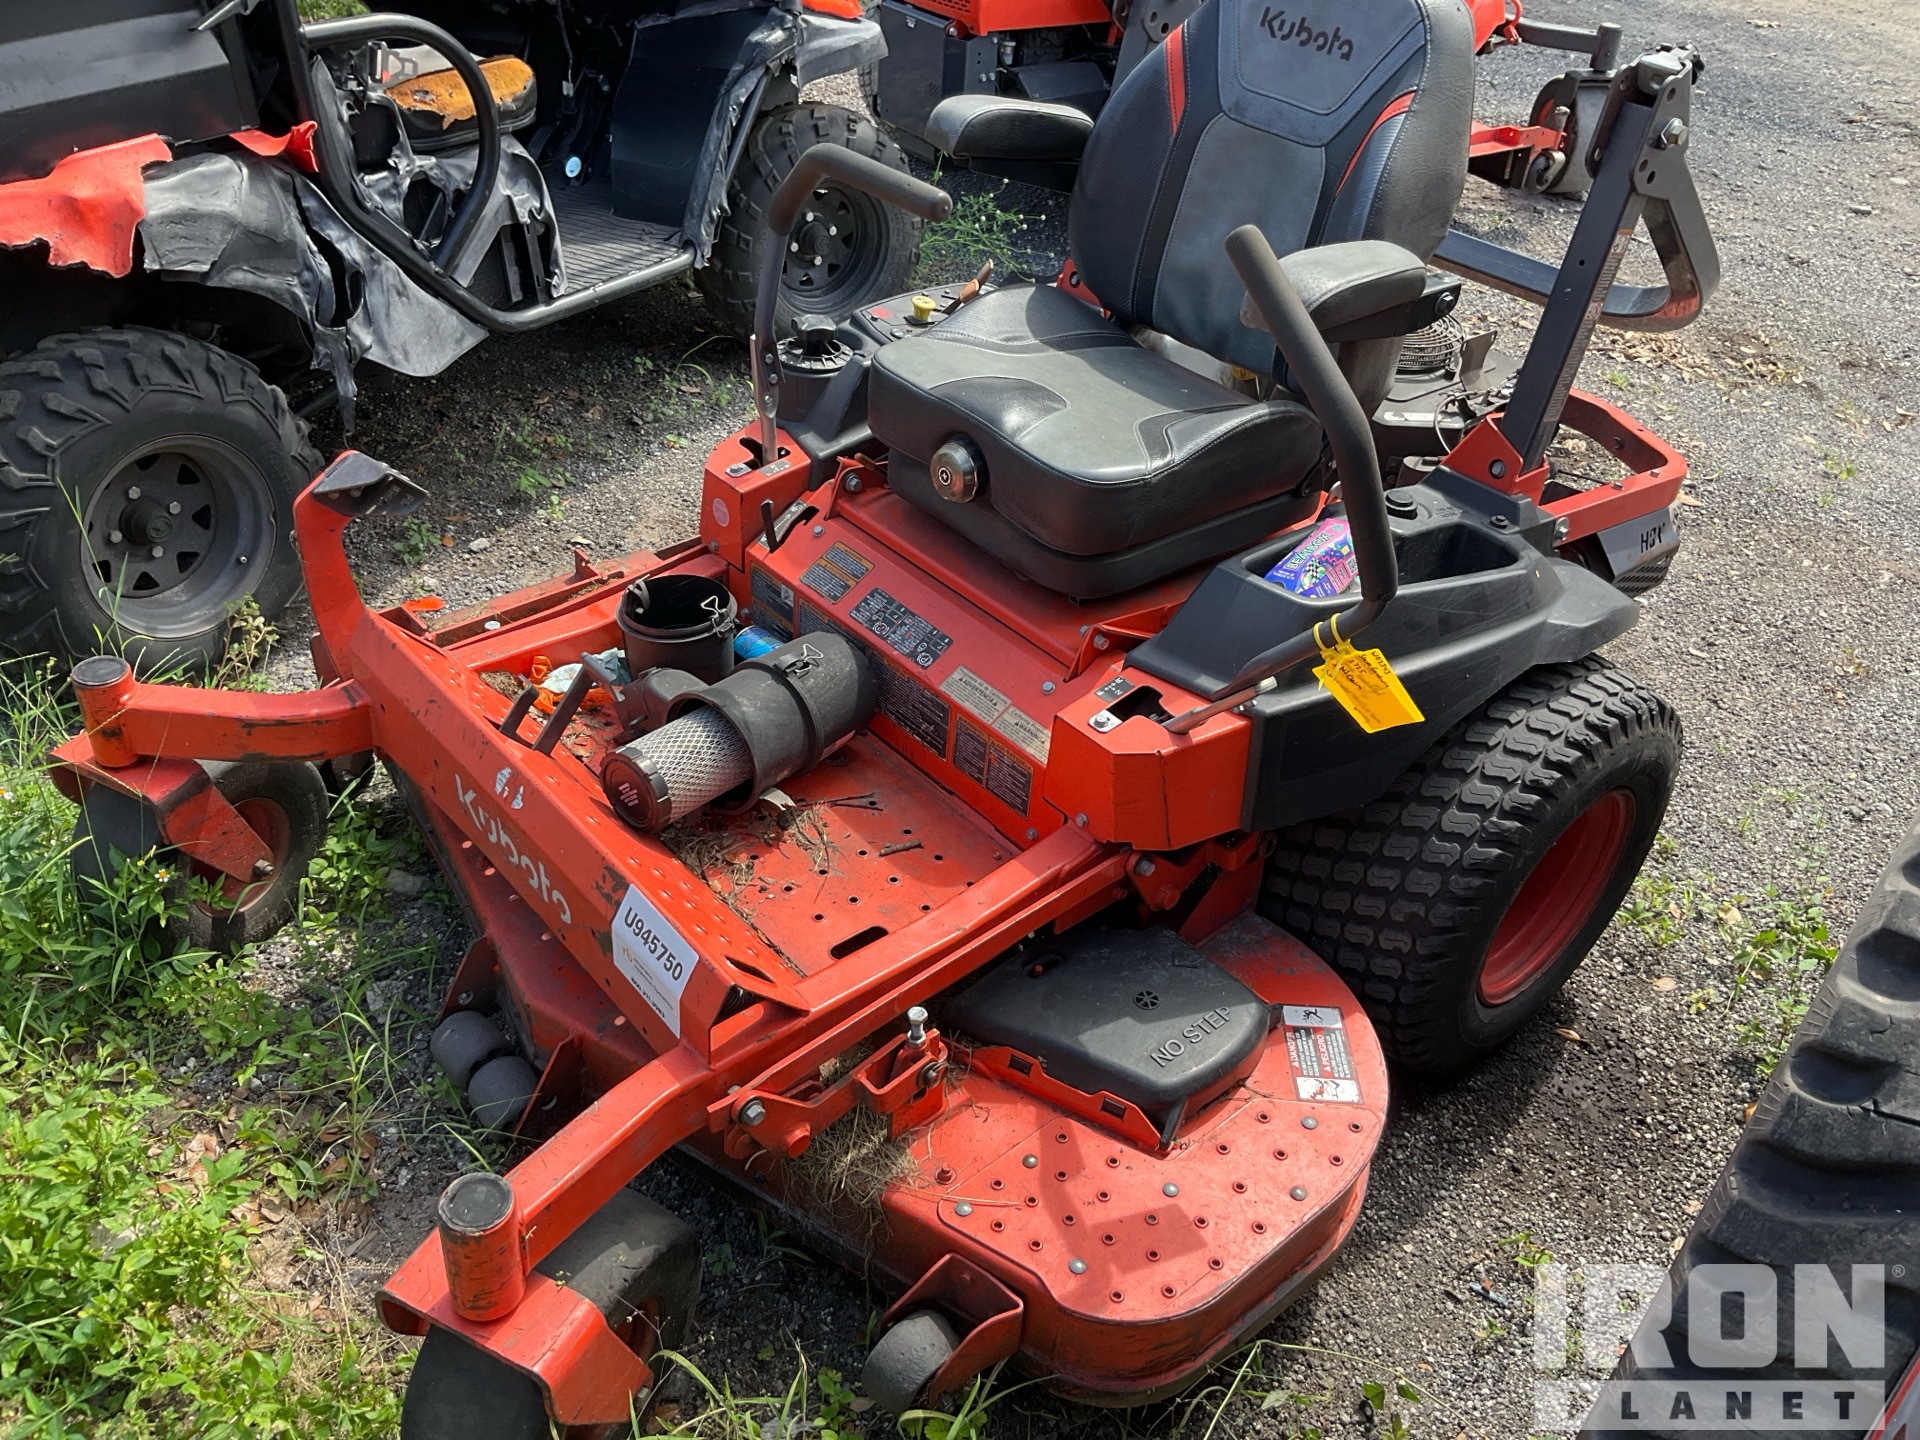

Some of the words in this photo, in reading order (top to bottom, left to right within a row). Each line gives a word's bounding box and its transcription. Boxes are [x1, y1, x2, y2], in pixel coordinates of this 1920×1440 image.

[1259, 6, 1354, 62] Kubota
[963, 679, 993, 703] ADVERTENCIA
[1018, 723, 1043, 743] WARNING
[454, 773, 572, 925] Kubota
[624, 907, 683, 981] U945750
[1150, 1039, 1185, 1067] NO
[1183, 1006, 1230, 1043] STEP
[1286, 1032, 1299, 1062] DANGER
[1317, 1034, 1331, 1068] PELIGRO
